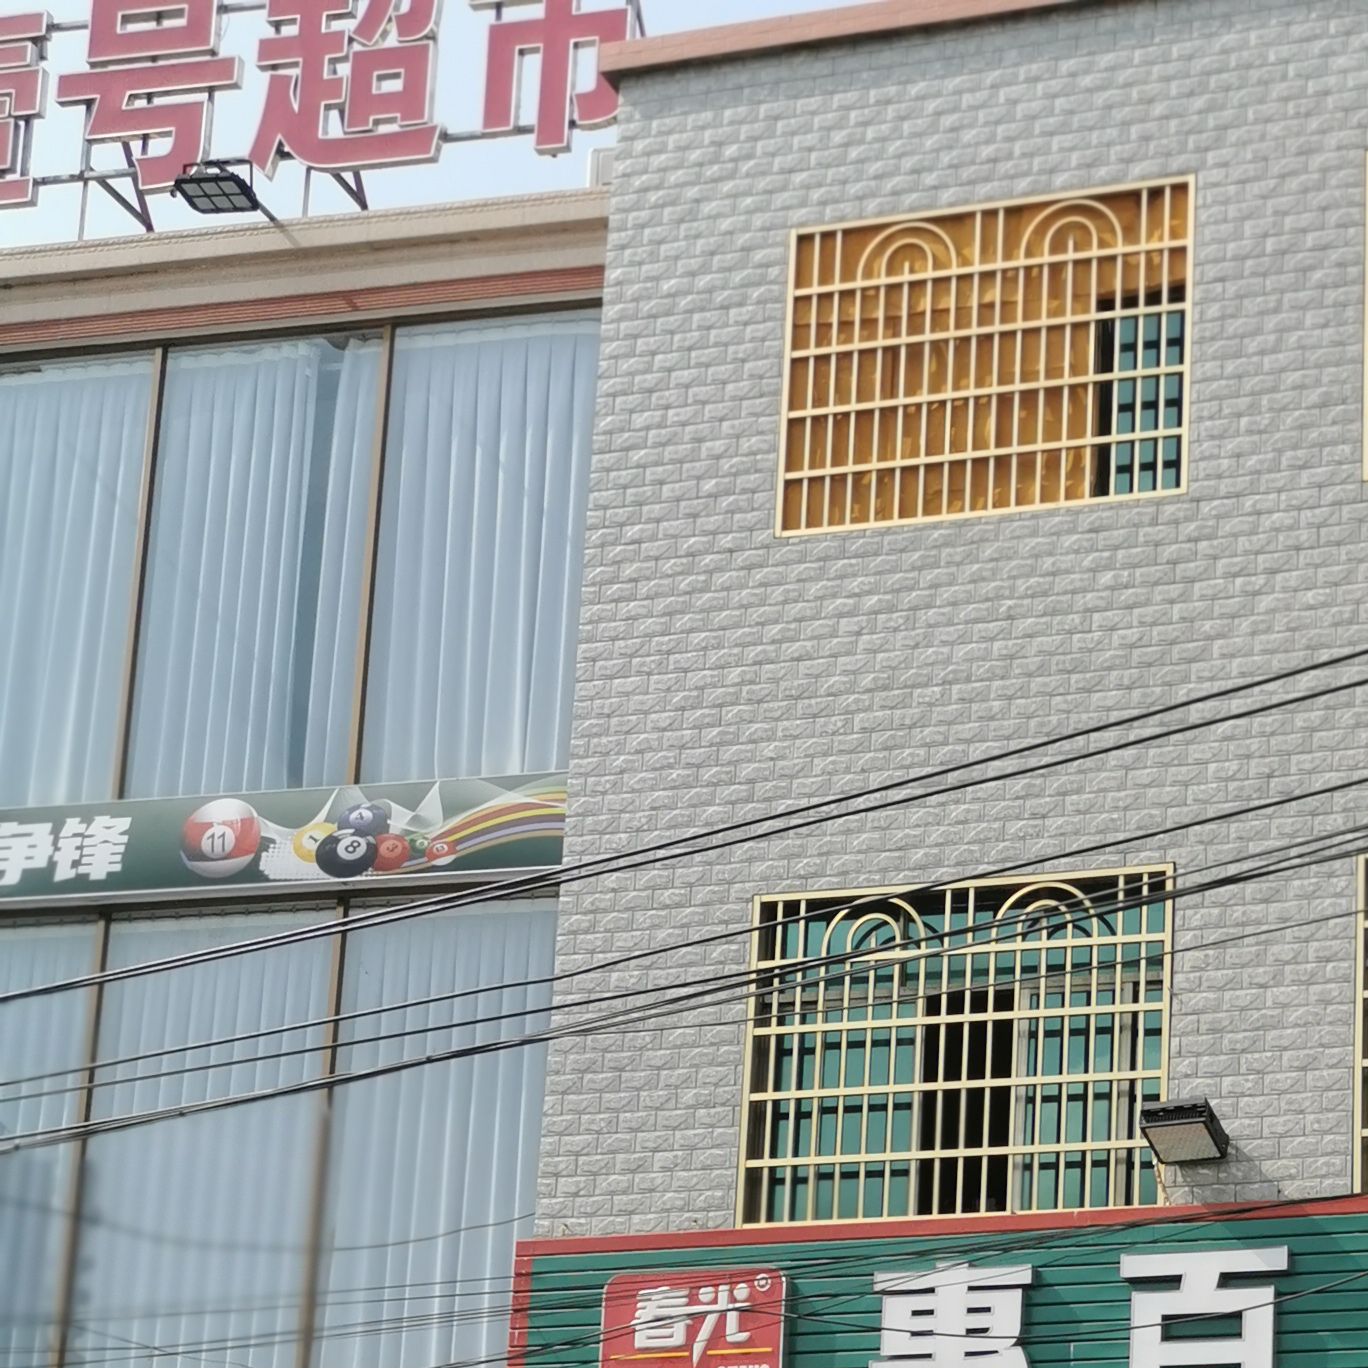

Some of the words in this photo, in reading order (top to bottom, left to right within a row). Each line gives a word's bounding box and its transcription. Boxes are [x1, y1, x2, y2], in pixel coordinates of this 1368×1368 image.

[206, 831, 228, 853] 11
[343, 838, 361, 854] 8
[631, 1283, 752, 1368] 春光
